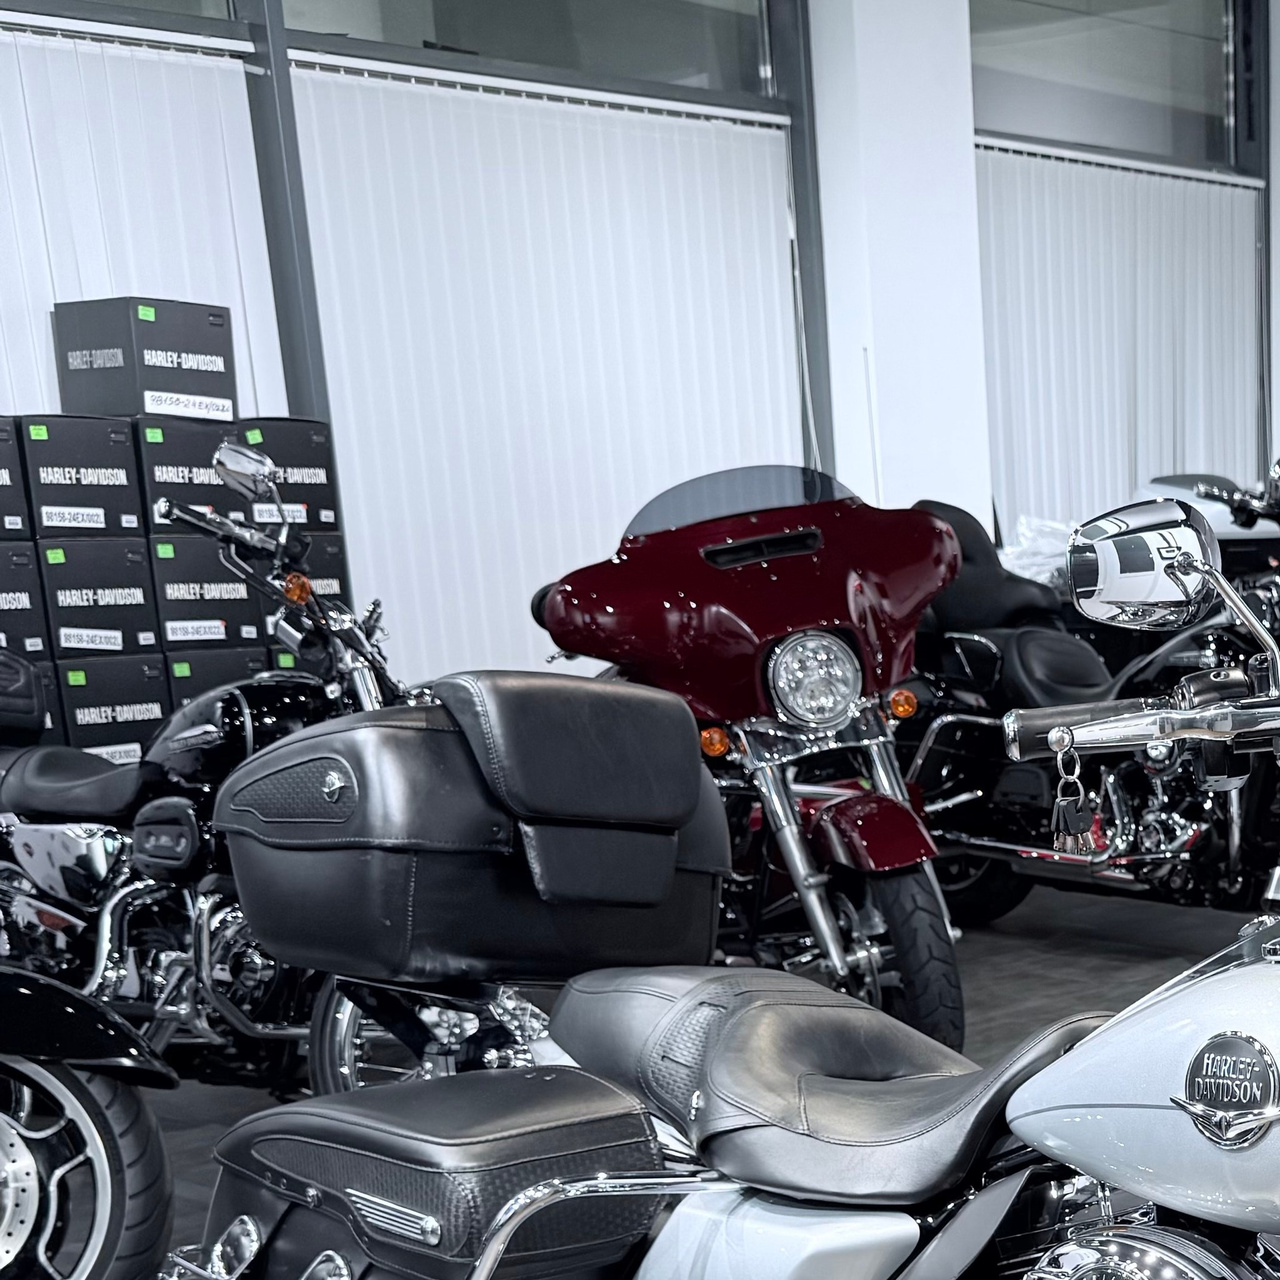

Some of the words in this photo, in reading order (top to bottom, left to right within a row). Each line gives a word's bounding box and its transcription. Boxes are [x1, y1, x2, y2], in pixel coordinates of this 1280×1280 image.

[67, 348, 125, 370] HARLEY-DAVIDSON
[144, 349, 226, 373] HARLEY-DAVIDSON
[39, 466, 129, 486] HARLEY-DAVIDSON
[56, 587, 146, 607] HARLEY-DAVIDSON
[165, 582, 249, 600] HARLEY-DAVIDSON
[75, 702, 164, 726] HARLEY-DAVIDSON
[1195, 1078, 1263, 1104] DAVIDSON
